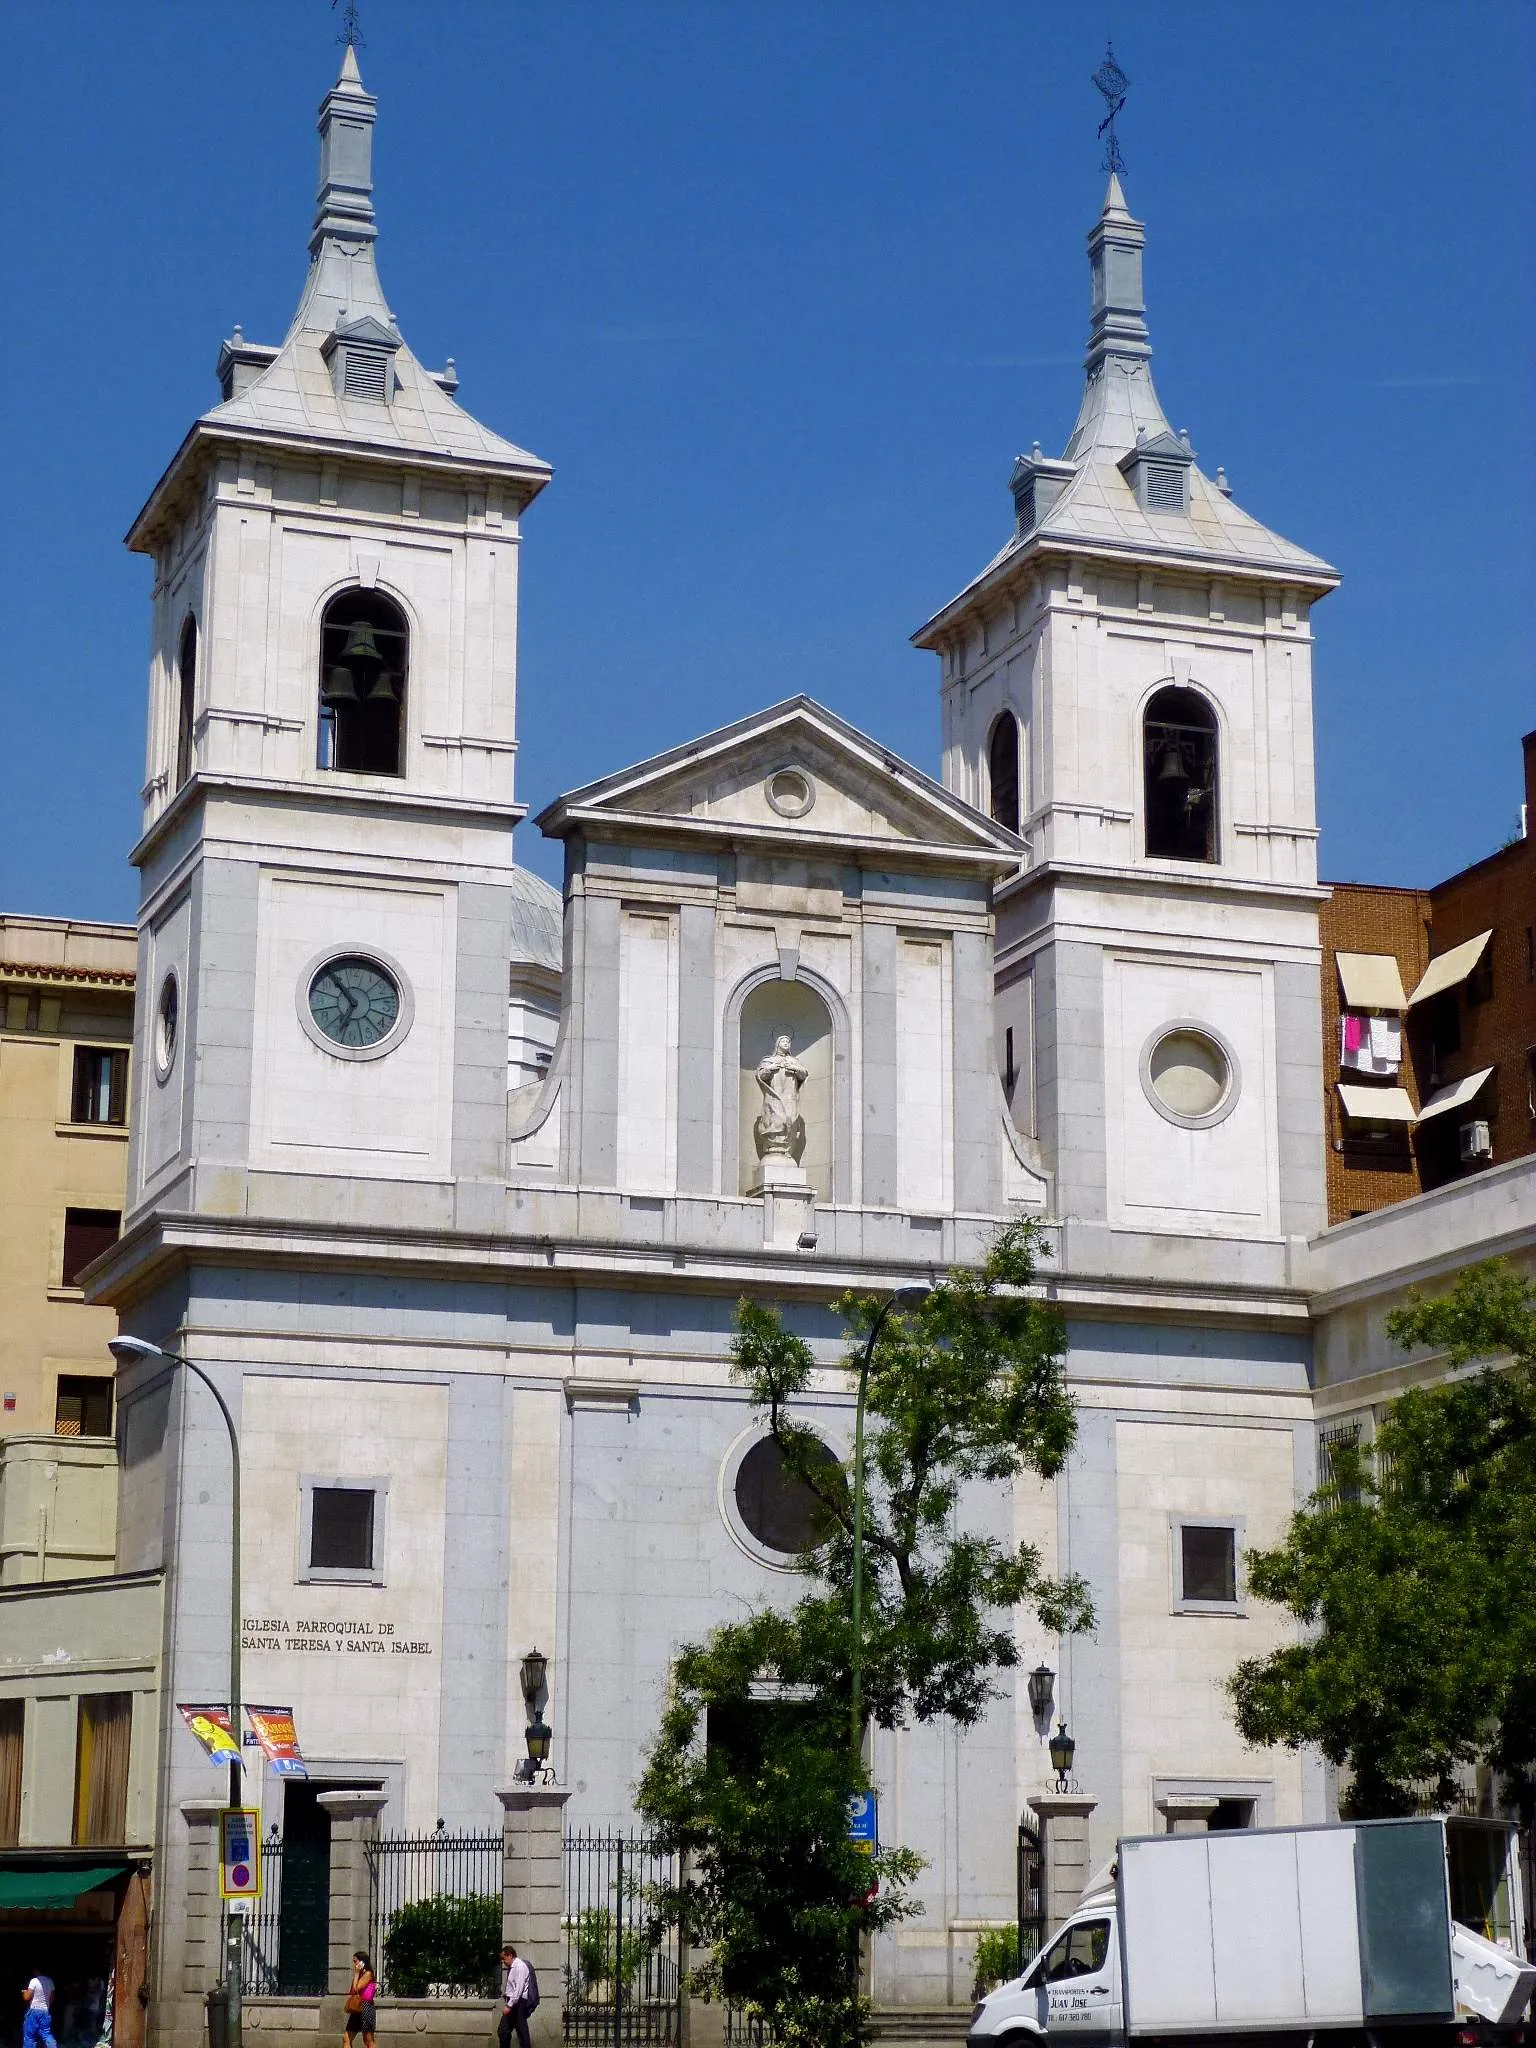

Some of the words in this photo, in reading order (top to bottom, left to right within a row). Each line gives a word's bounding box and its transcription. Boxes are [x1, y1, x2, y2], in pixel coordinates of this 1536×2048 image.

[242, 1619, 290, 1632] IGLESIA
[296, 1621, 374, 1635] PARROQUIAL
[378, 1623, 395, 1635] DE
[241, 1637, 281, 1650] SANTA
[285, 1639, 331, 1652] TERESA
[336, 1640, 344, 1652] Y
[346, 1640, 386, 1653] SANTA
[391, 1641, 433, 1655] ISABEL
[1051, 1998, 1068, 2008] JUAN
